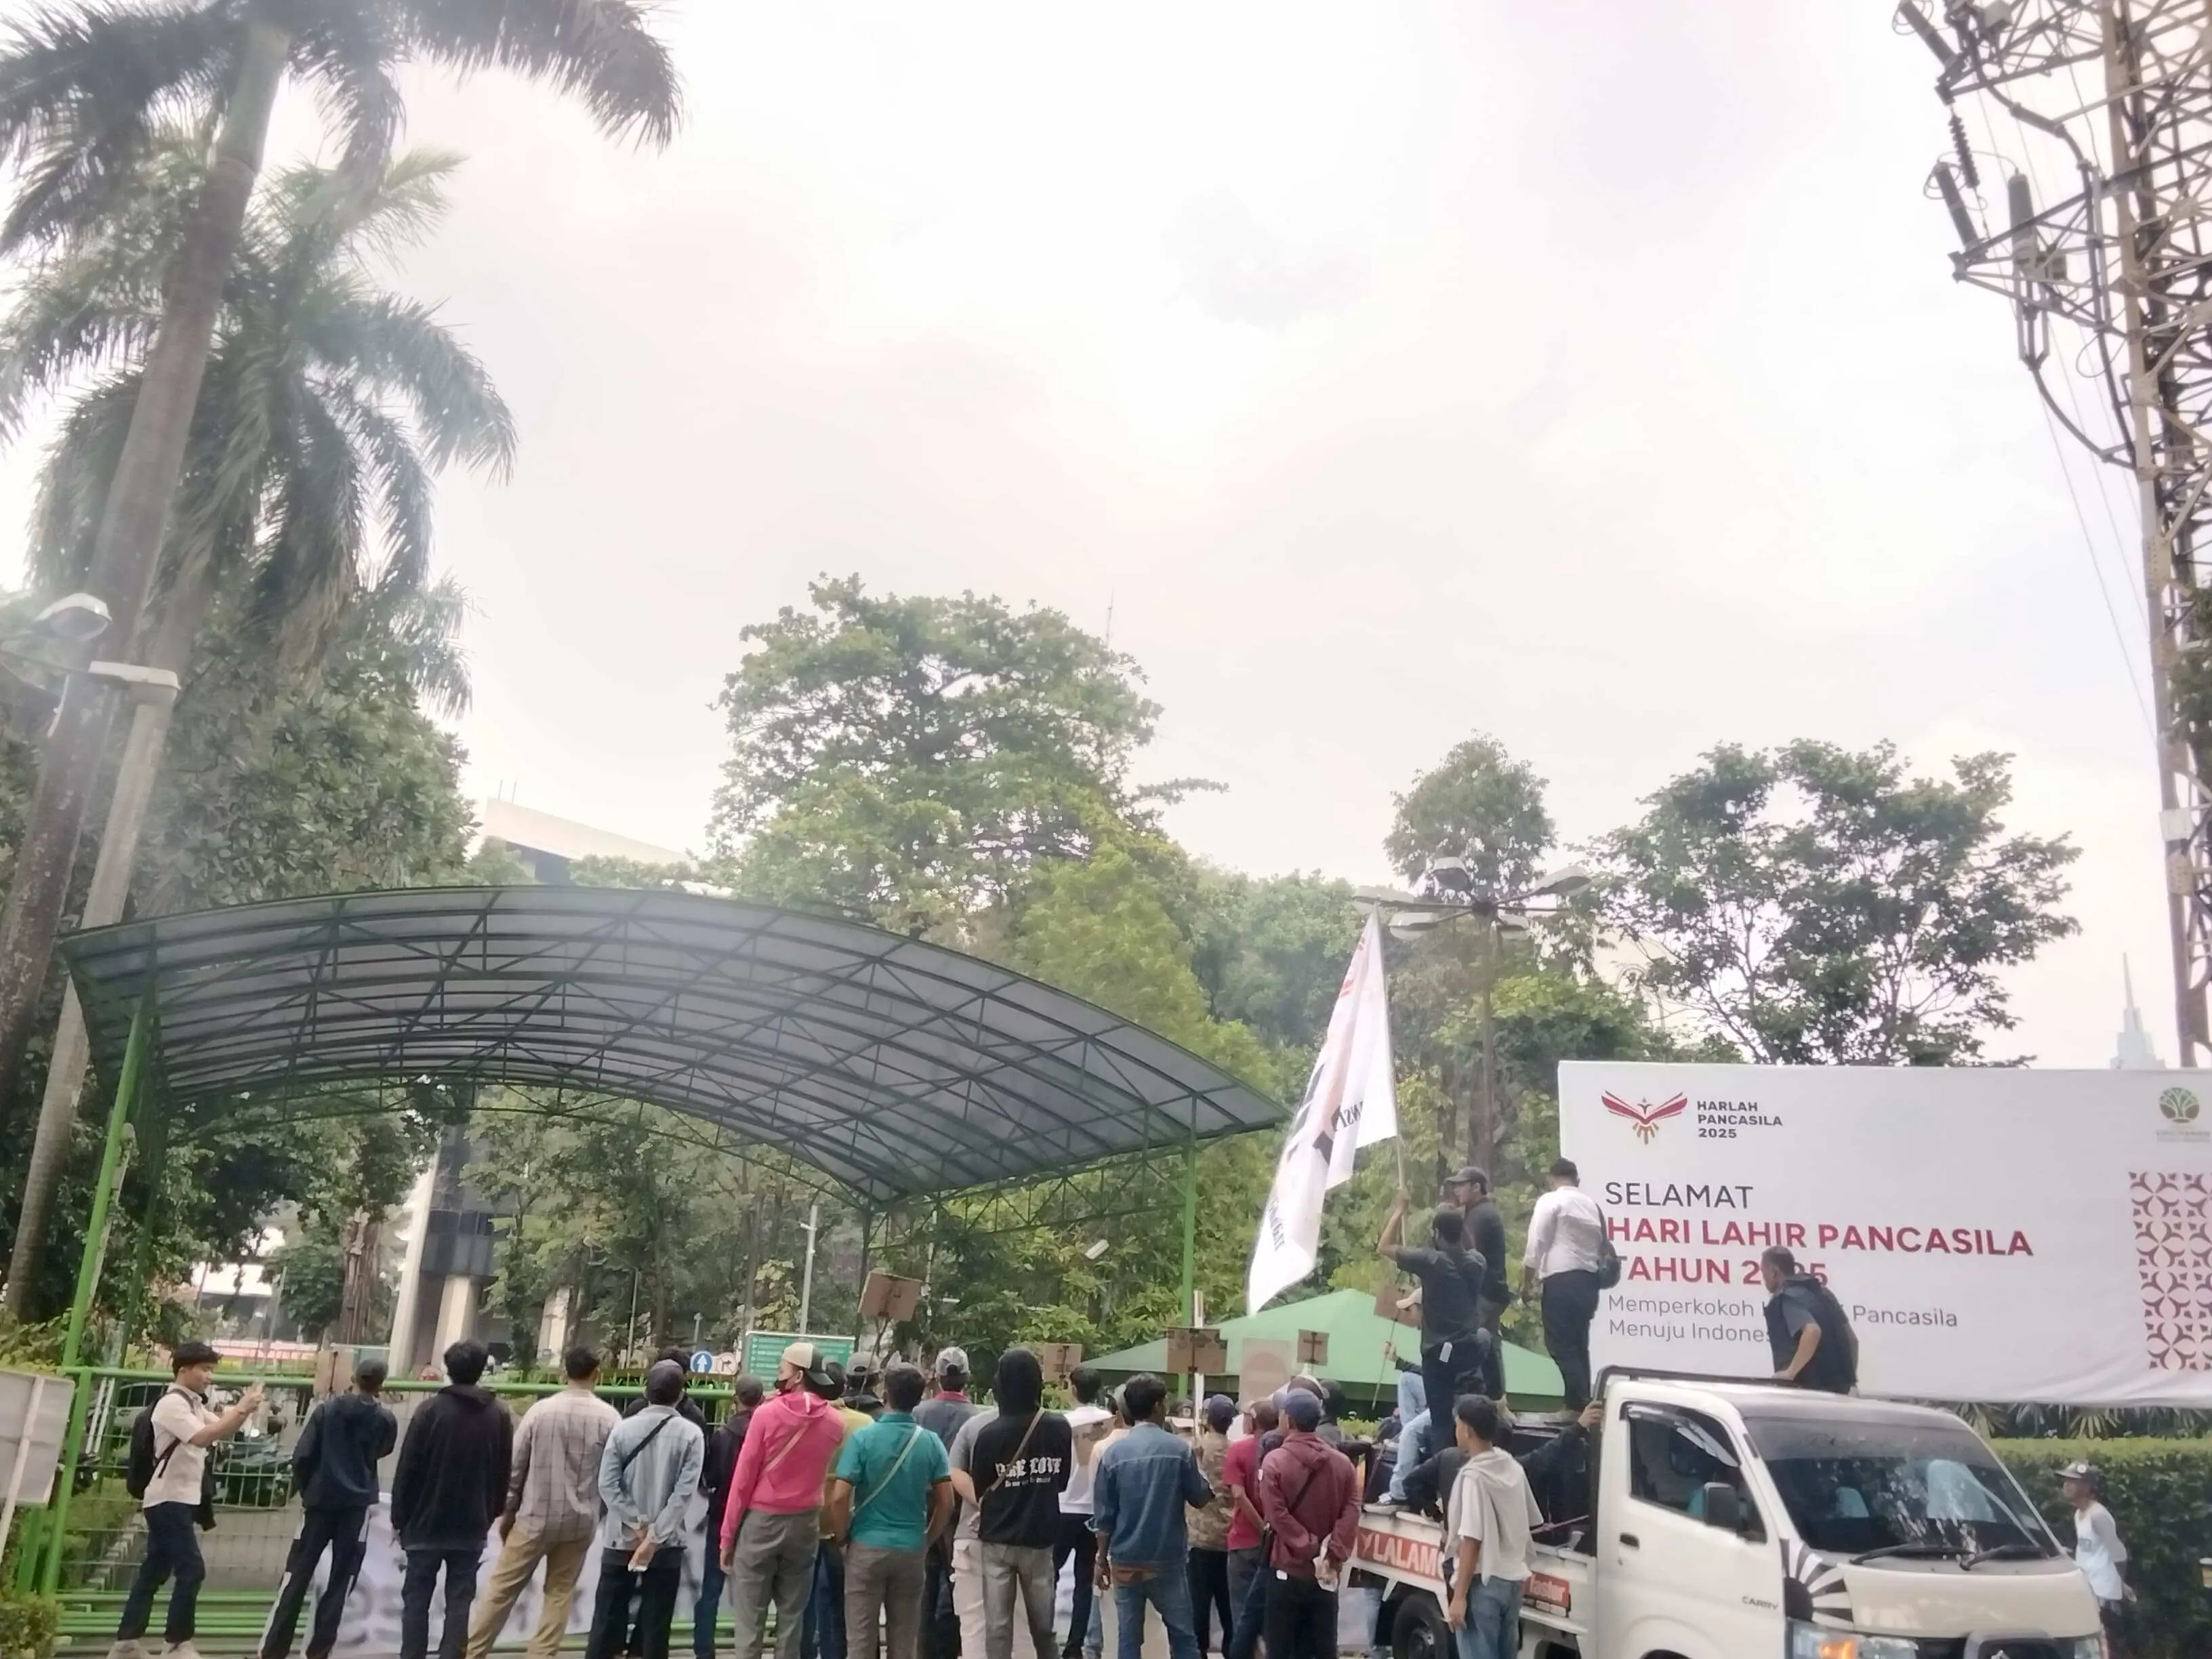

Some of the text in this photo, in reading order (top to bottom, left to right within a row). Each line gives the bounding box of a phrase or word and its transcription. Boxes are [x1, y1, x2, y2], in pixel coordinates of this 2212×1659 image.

[1697, 1101, 1758, 1112] HARLAH
[1698, 1114, 1782, 1126] PANCASILA
[1698, 1128, 1737, 1139] 2025
[1605, 1182, 1754, 1209] SELAMAT
[1607, 1217, 2034, 1256] HARI LAHIR PANCASILA
[1742, 1260, 1828, 1287] 25
[1609, 1295, 1754, 1317] Memperkokoh
[1853, 1305, 1957, 1327] Pancasila
[1610, 1319, 1770, 1342] Menuju Indone
[1742, 1596, 1778, 1610] CARRY
